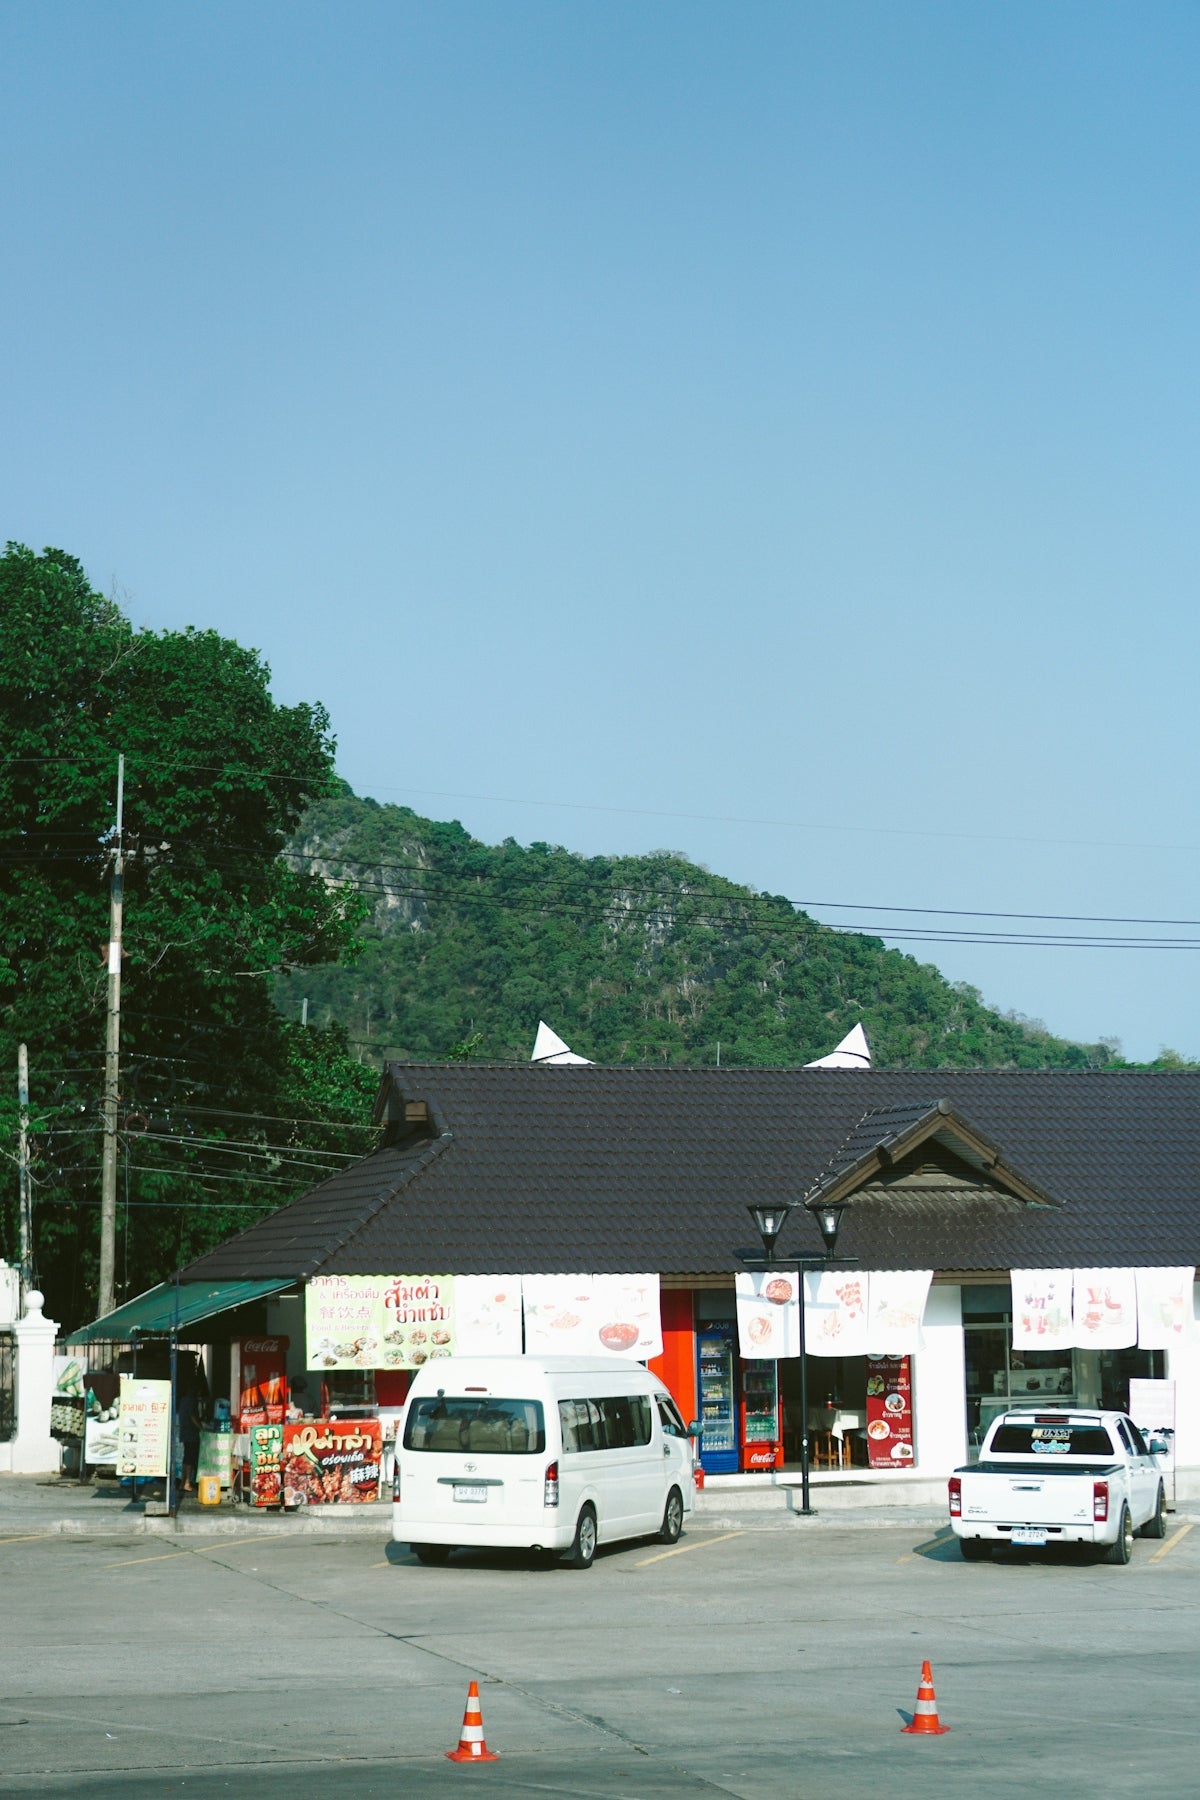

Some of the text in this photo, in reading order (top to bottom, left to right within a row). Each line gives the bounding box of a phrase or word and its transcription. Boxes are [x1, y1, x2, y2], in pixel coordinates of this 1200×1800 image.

[384, 1279, 440, 1309] ส้มตำ
[255, 1427, 280, 1445] ลูก
[255, 1444, 279, 1465] ชิ้น
[321, 1449, 364, 1466] อร่อยเด็ด
[255, 1465, 280, 1475] ทอด
[350, 1464, 380, 1484] 麻辣
